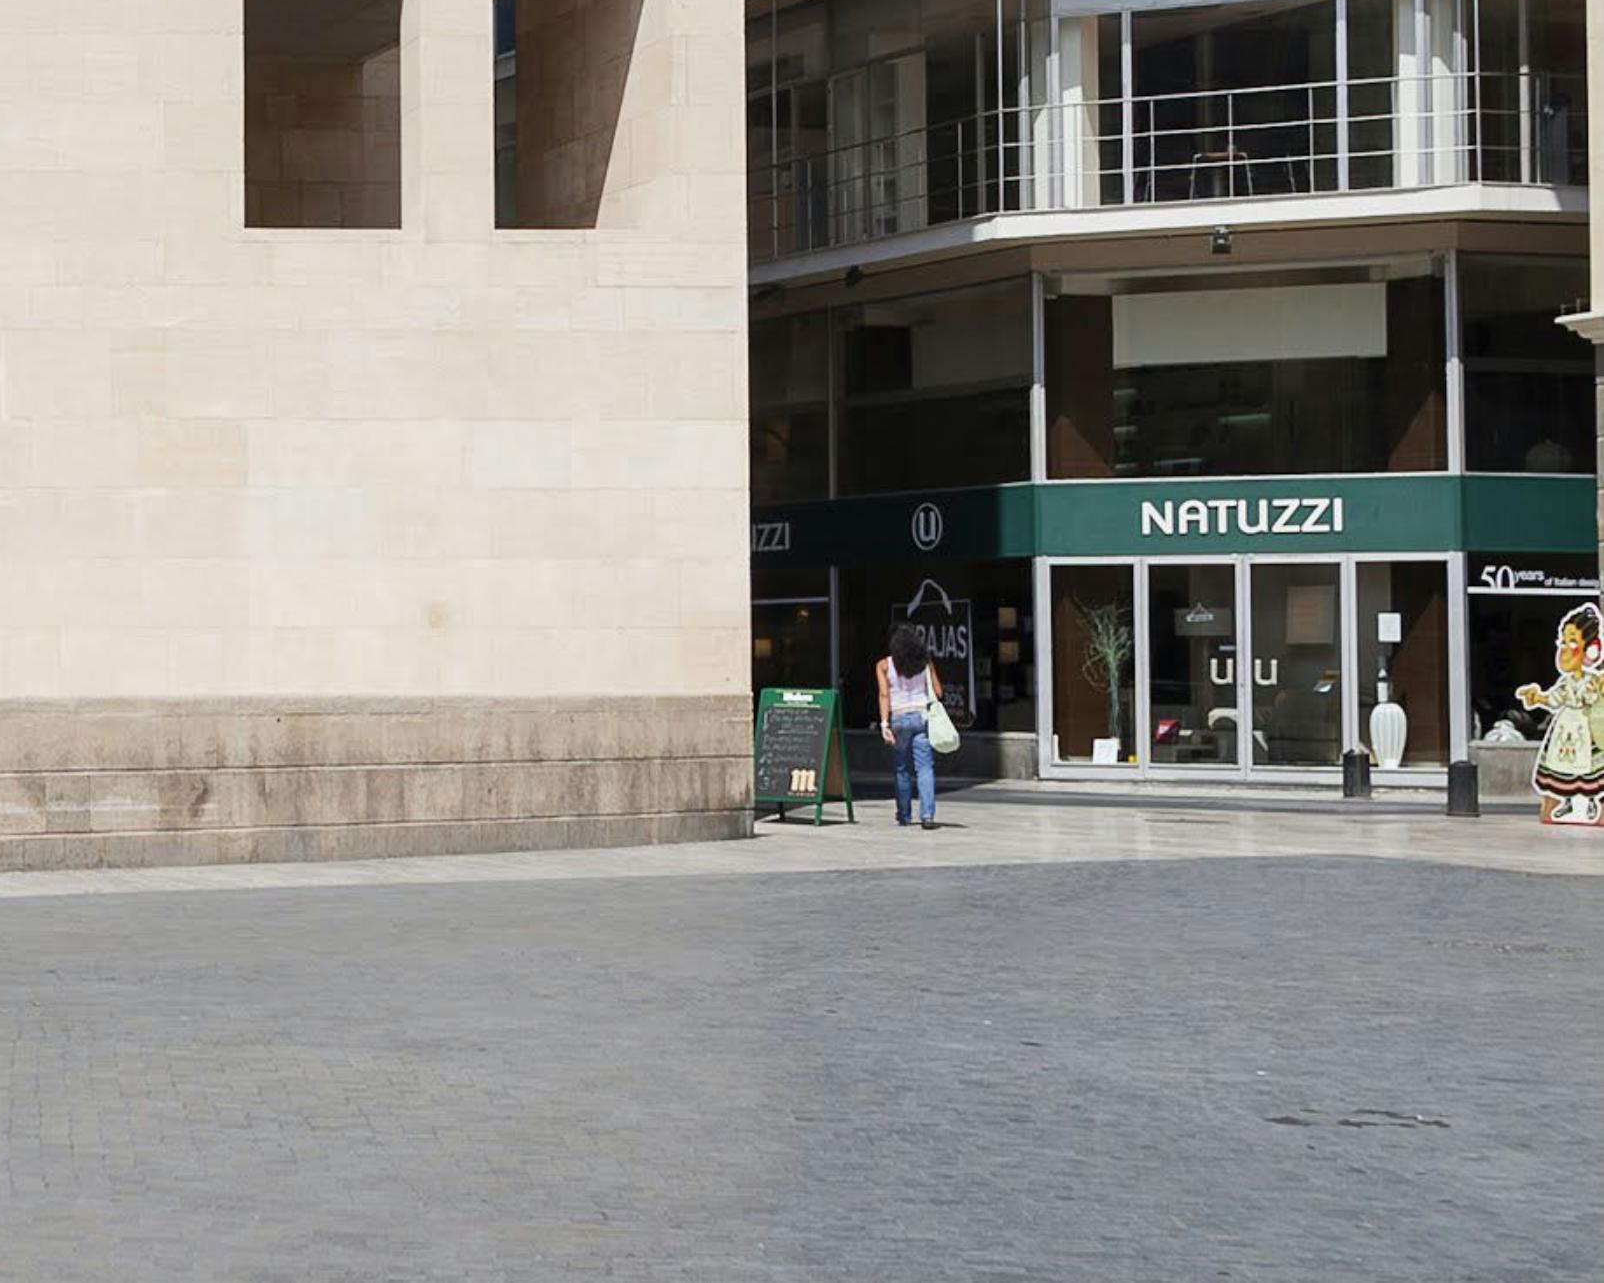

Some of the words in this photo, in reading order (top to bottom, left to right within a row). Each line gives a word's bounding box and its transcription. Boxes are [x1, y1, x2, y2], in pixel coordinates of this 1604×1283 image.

[1141, 498, 1343, 535] NATUZZI
[1481, 564, 1515, 590] 50
[1514, 570, 1545, 583] years
